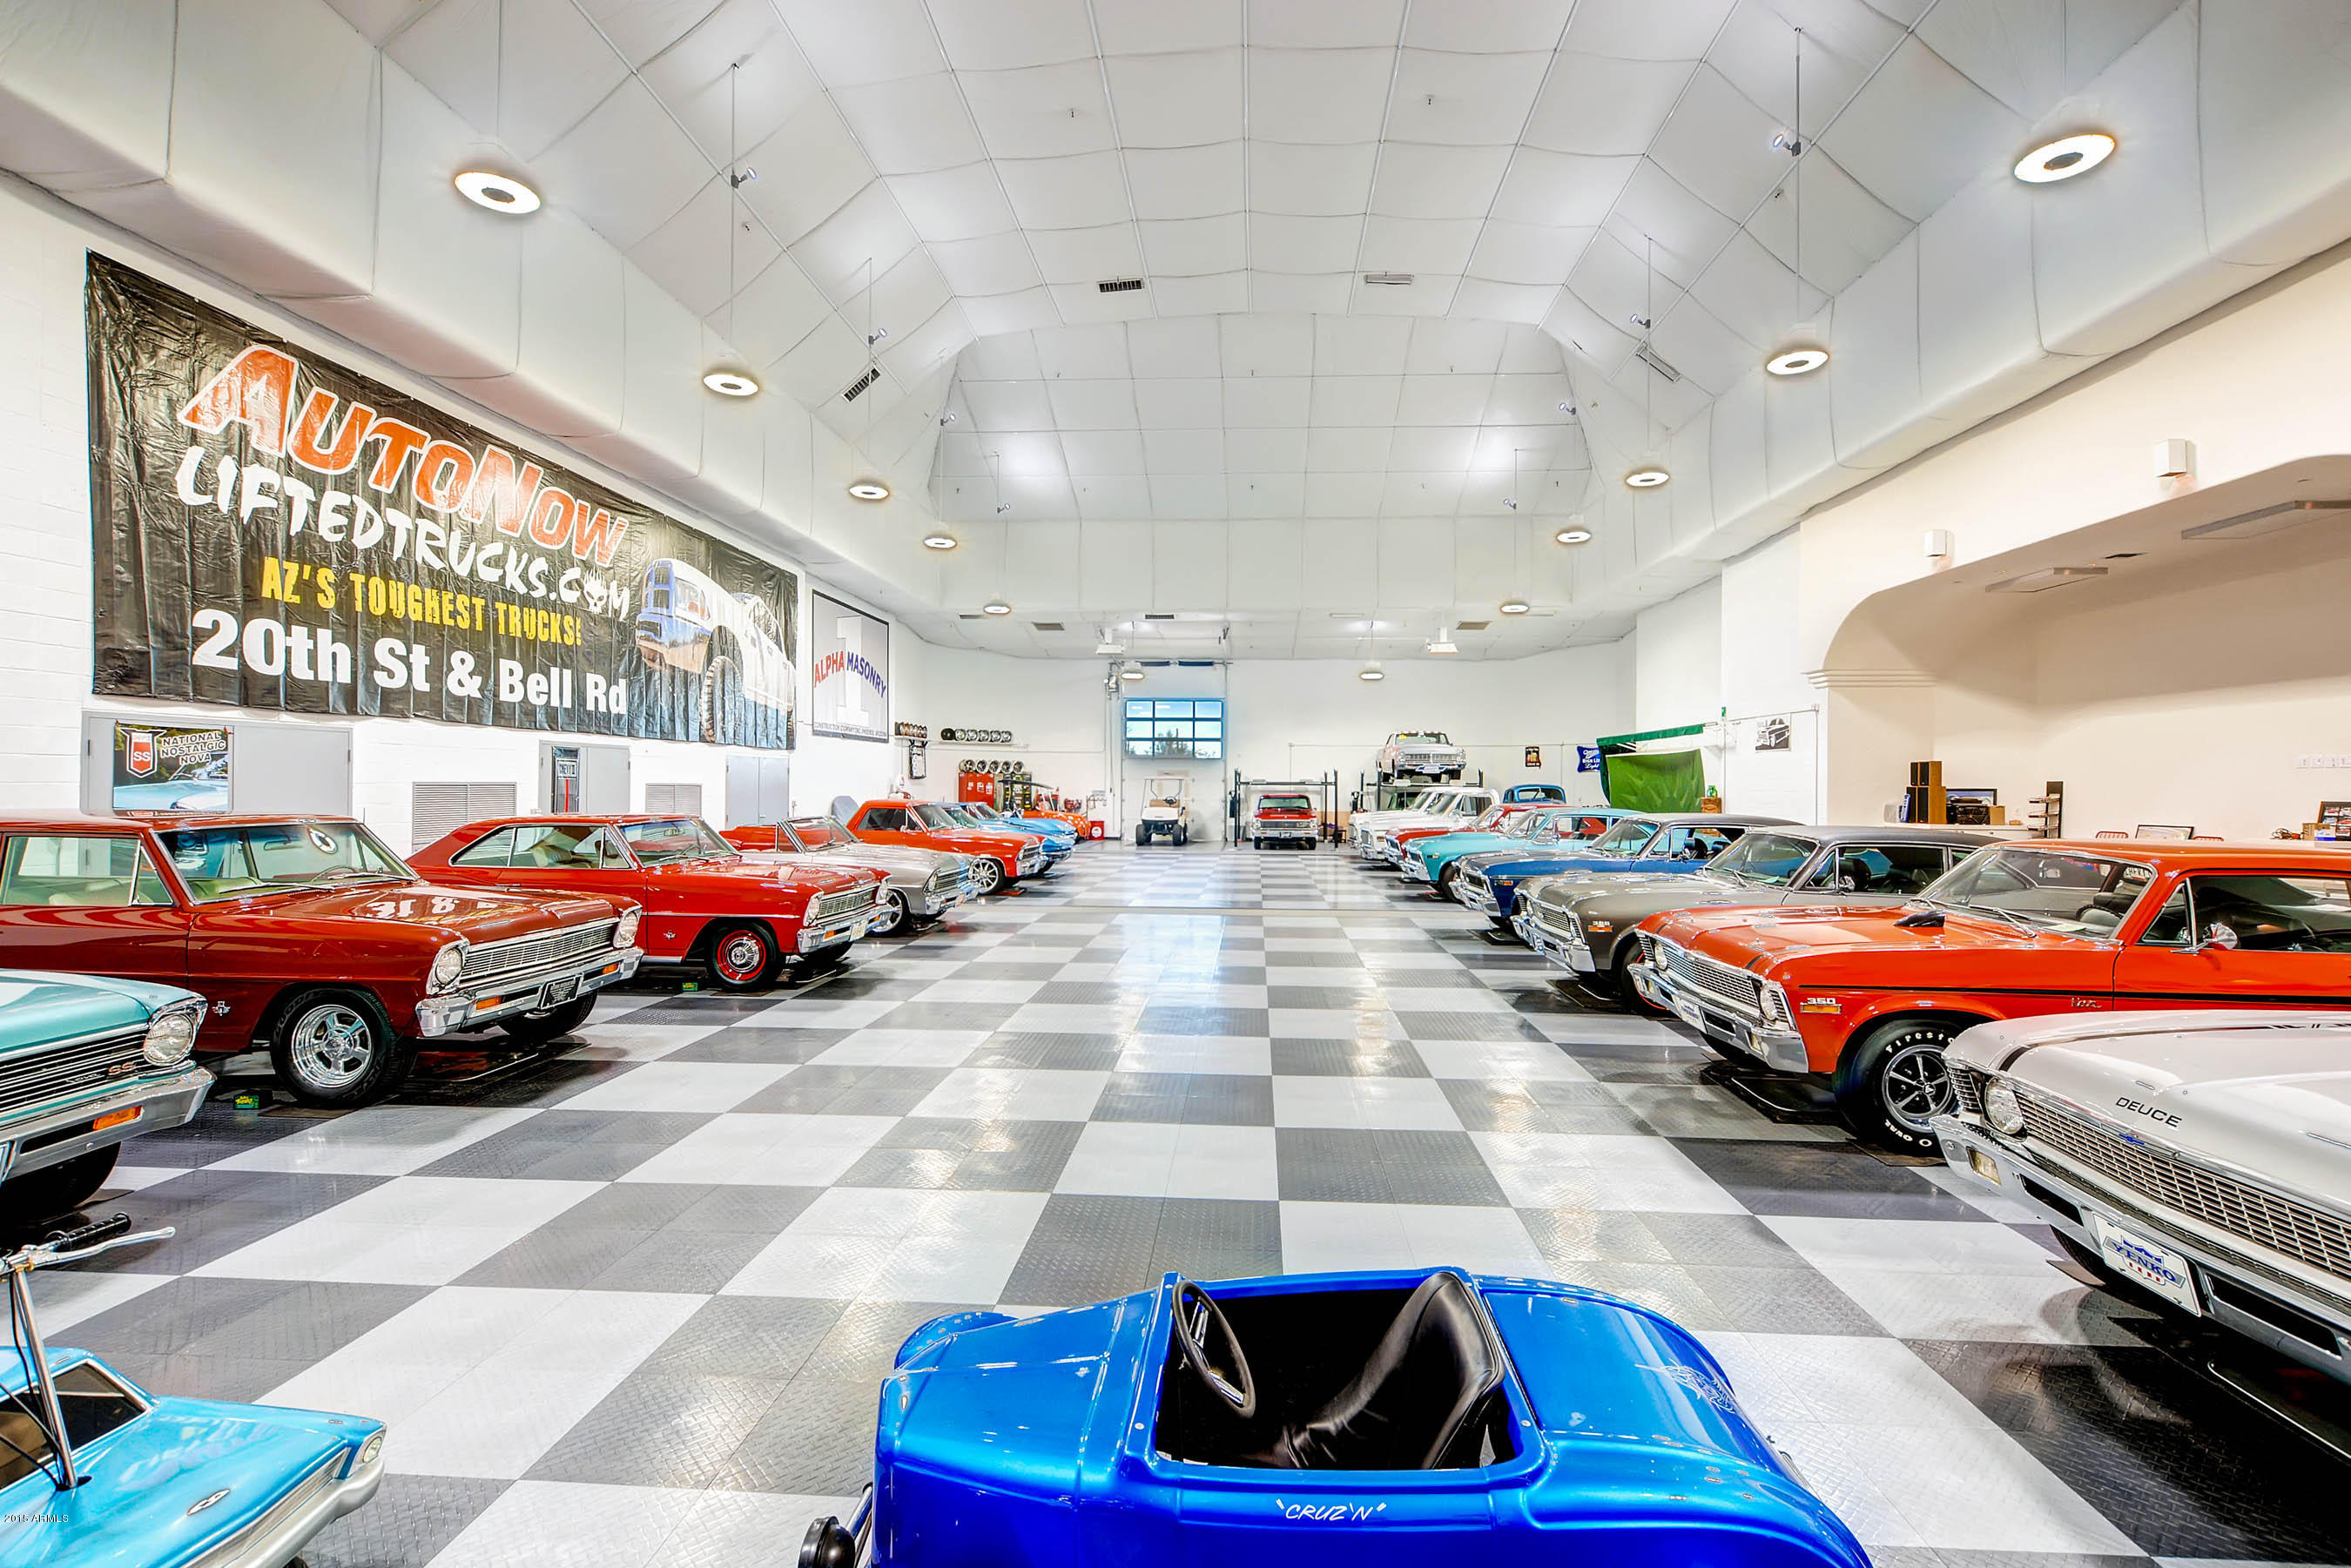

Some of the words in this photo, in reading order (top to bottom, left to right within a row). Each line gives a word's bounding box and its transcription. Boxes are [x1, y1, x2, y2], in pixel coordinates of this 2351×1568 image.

[261, 555, 336, 611] AZ'S
[349, 571, 484, 633] TOUGHEST
[495, 602, 582, 647] TRUCKS!
[191, 609, 352, 683] 20th
[373, 636, 434, 692] St
[447, 650, 482, 699] &
[499, 664, 572, 710] Bell
[585, 672, 627, 715] Rd
[814, 651, 845, 688] ALPHA
[846, 651, 886, 698] MASONRY
[161, 741, 226, 758] NOSTALGIC
[162, 732, 221, 746] NATIONAL
[134, 751, 151, 762] SS
[179, 752, 212, 765] NOVA
[1885, 1032, 1954, 1053] Firesto
[108, 1062, 135, 1075] SS
[2115, 1097, 2182, 1127] DEUCE
[2112, 1242, 2176, 1282] YENKO
